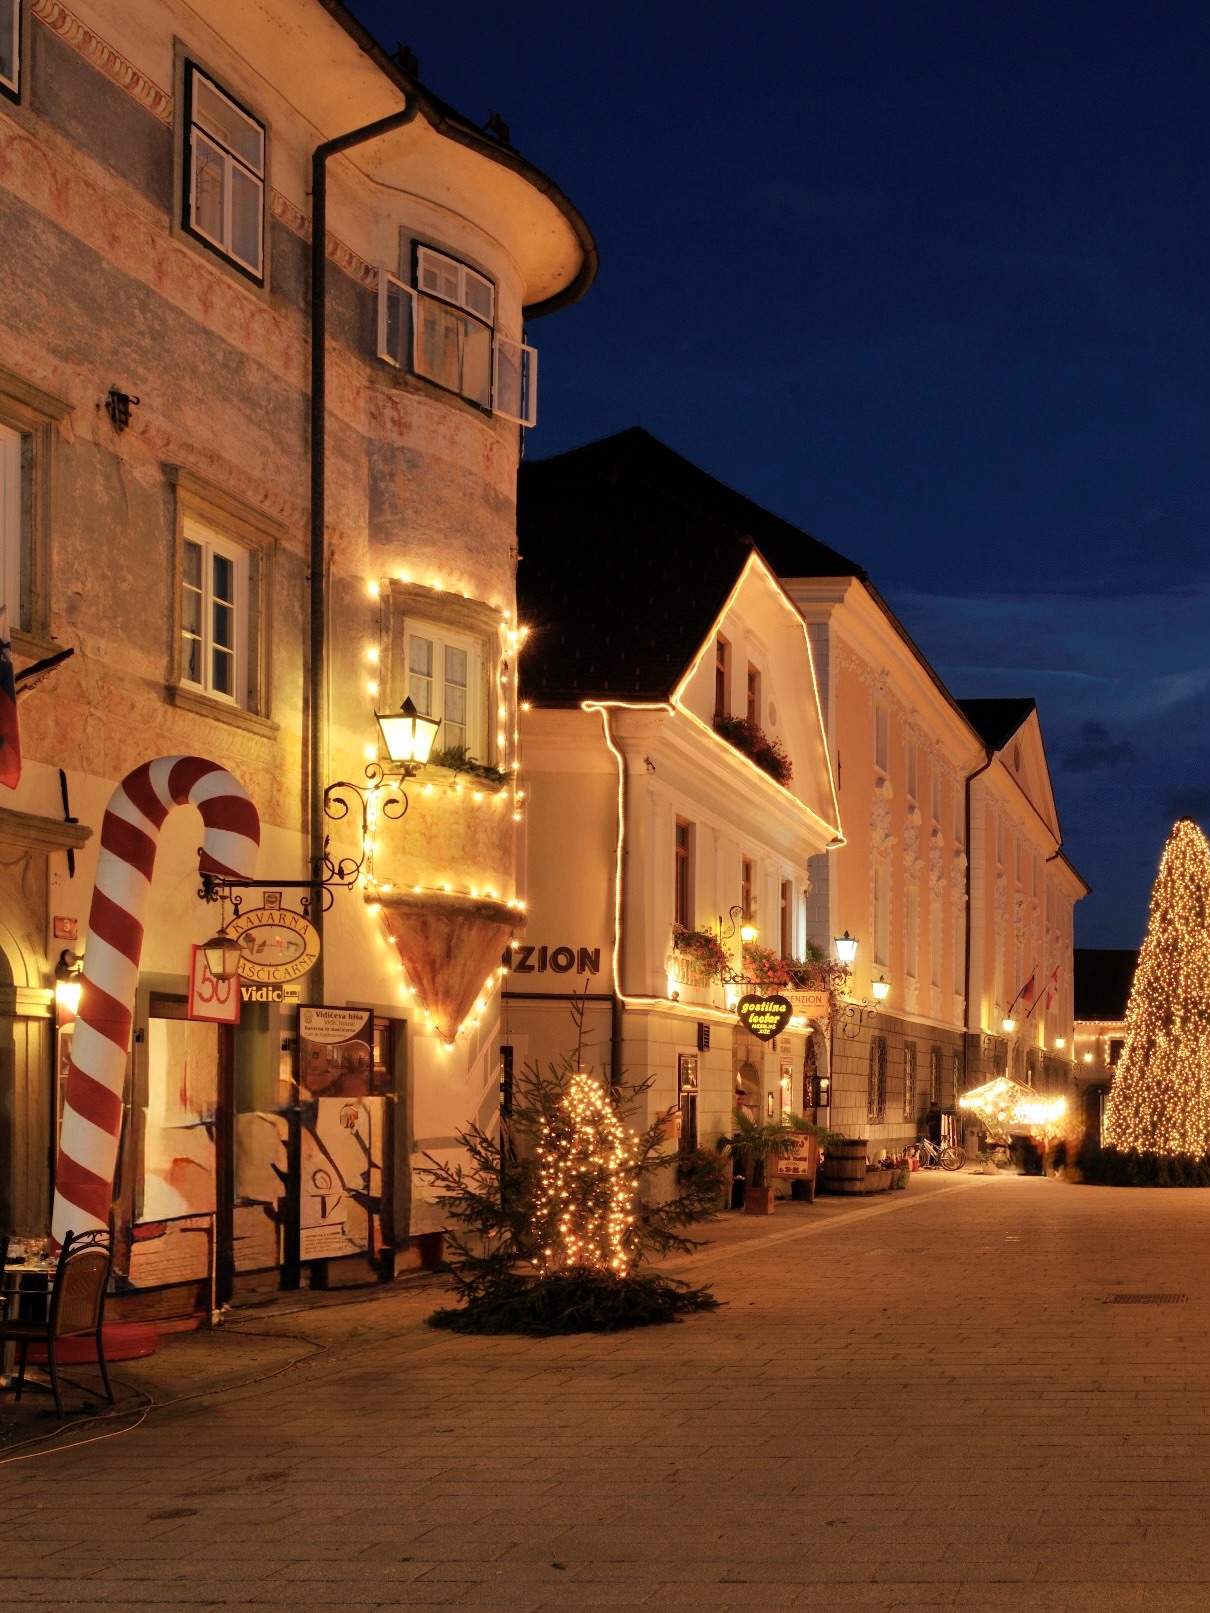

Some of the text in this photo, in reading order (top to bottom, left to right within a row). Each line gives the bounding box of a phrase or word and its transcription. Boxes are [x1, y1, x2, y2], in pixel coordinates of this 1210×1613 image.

[63, 919, 71, 932] 3
[232, 912, 310, 936] KAVARNA
[240, 986, 283, 1002] Vidic
[741, 1002, 787, 1014] gostilna
[748, 1013, 781, 1024] lectar
